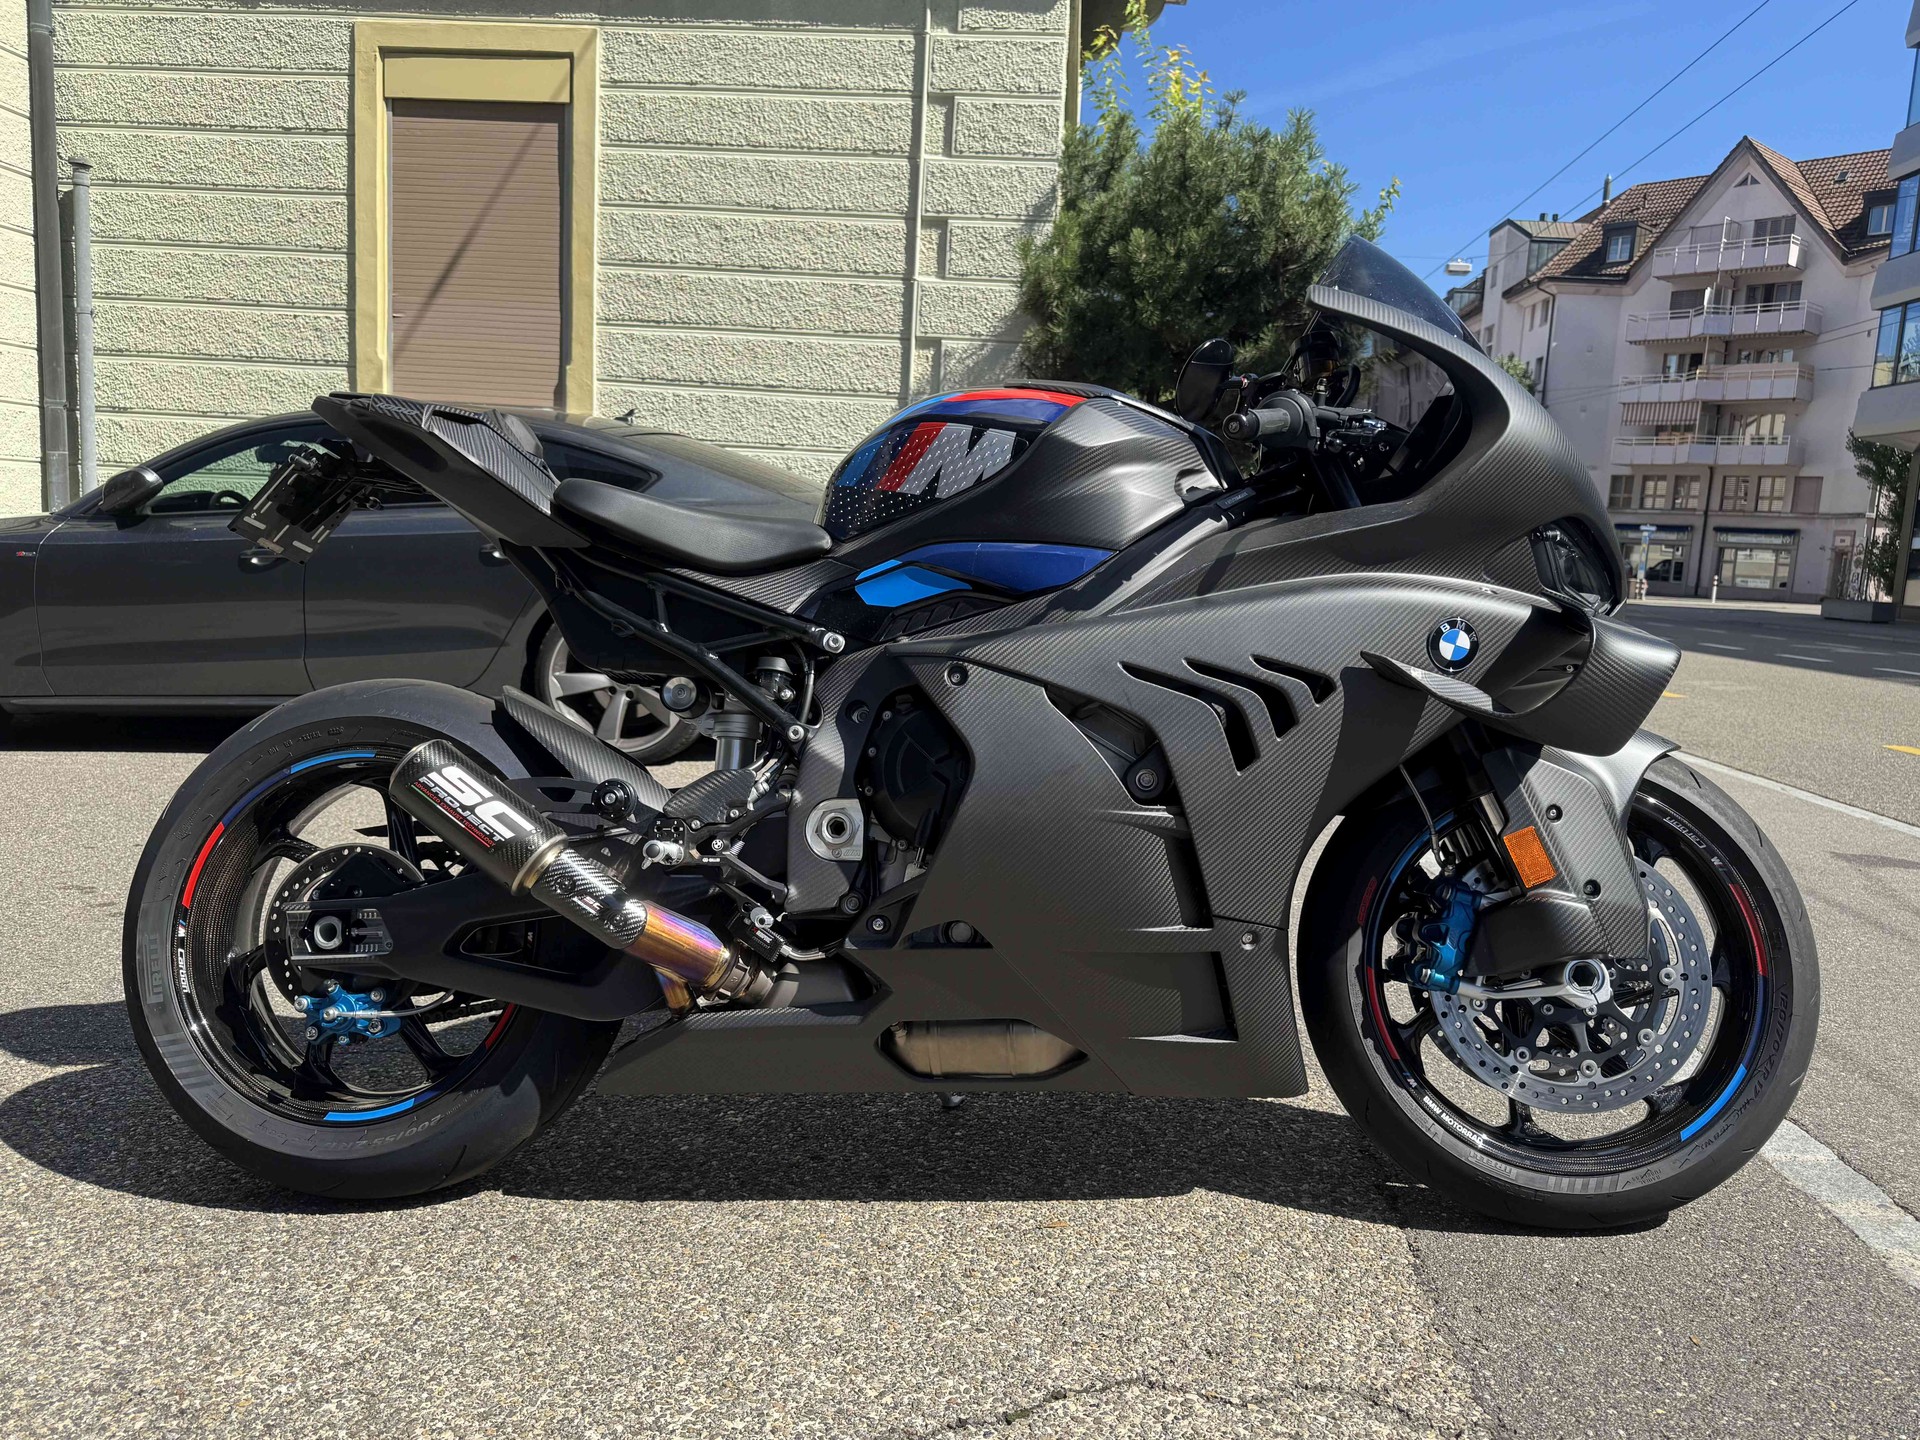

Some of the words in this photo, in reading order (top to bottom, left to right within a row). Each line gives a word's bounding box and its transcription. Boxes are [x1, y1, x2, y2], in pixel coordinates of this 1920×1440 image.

[1440, 620, 1477, 642] BMW
[414, 781, 440, 806] ADVANCED
[440, 802, 464, 823] EXHAUST
[463, 819, 496, 847] TECHNOLOGY
[418, 776, 505, 842] PROJECT
[427, 766, 536, 840] SC
[142, 934, 164, 1004] PIRELLI
[1772, 991, 1788, 1051] 120/70
[1422, 1095, 1443, 1116] BMW
[1440, 1111, 1484, 1147] MOTORRAD
[1467, 1149, 1517, 1180] PIRELLI
